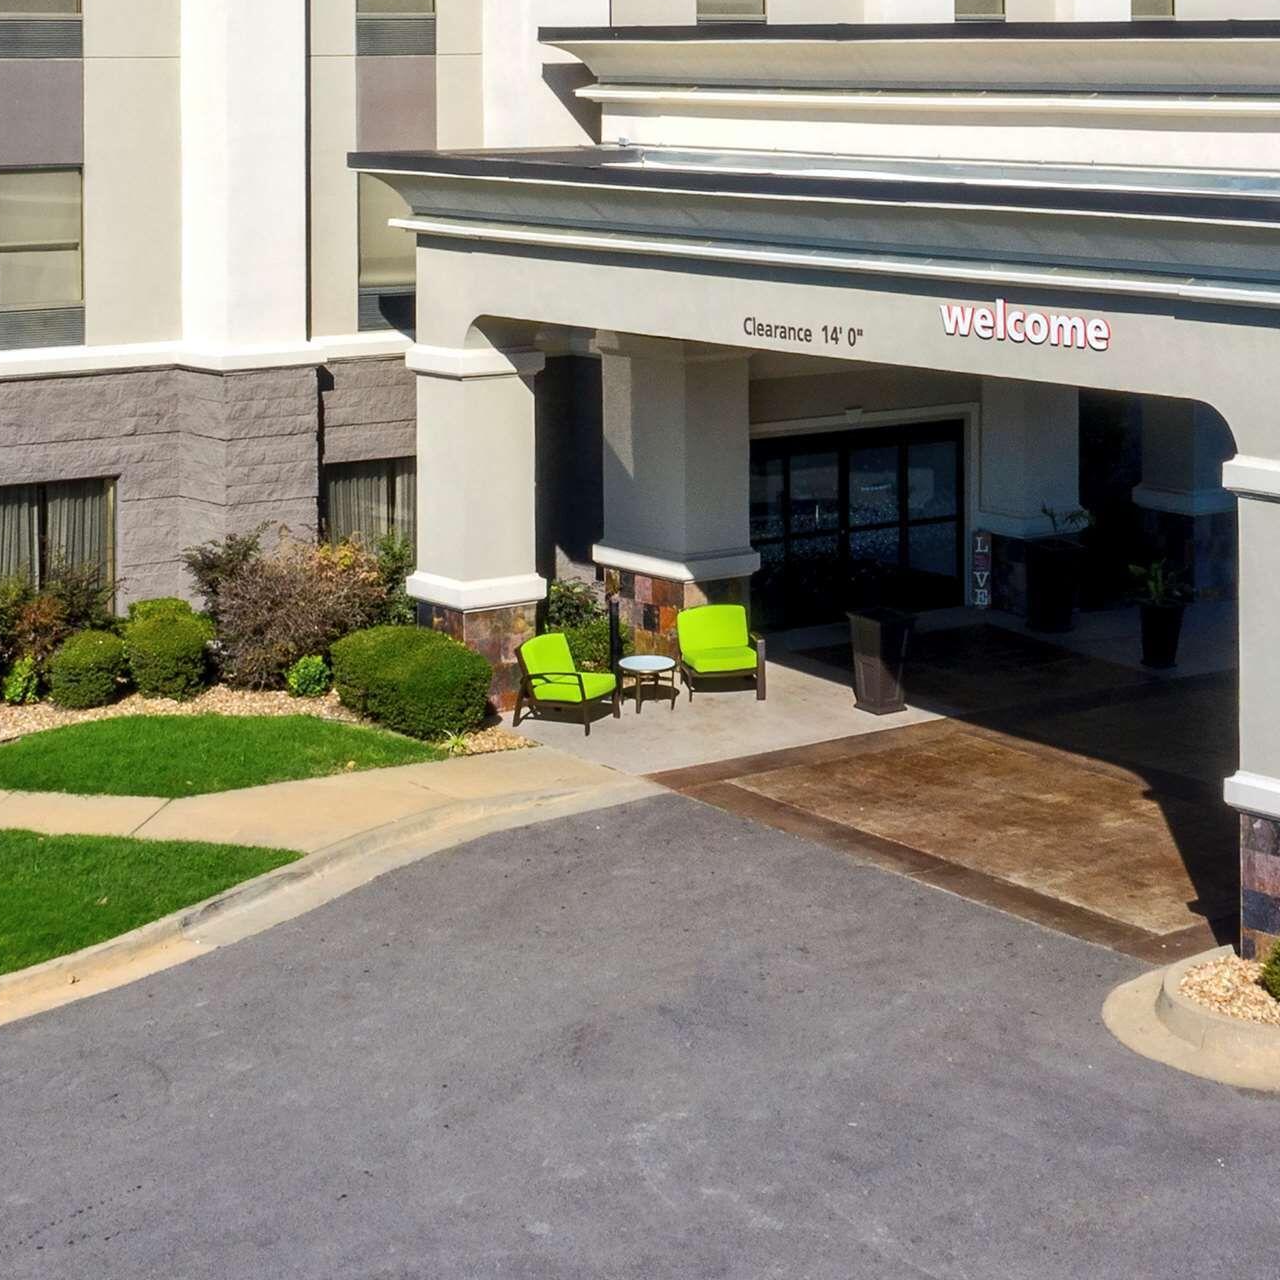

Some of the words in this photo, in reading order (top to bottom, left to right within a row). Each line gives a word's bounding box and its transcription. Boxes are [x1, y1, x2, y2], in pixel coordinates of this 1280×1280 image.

[743, 316, 813, 343] Clearance
[940, 298, 1112, 351] welcome
[974, 536, 990, 605] LVE
